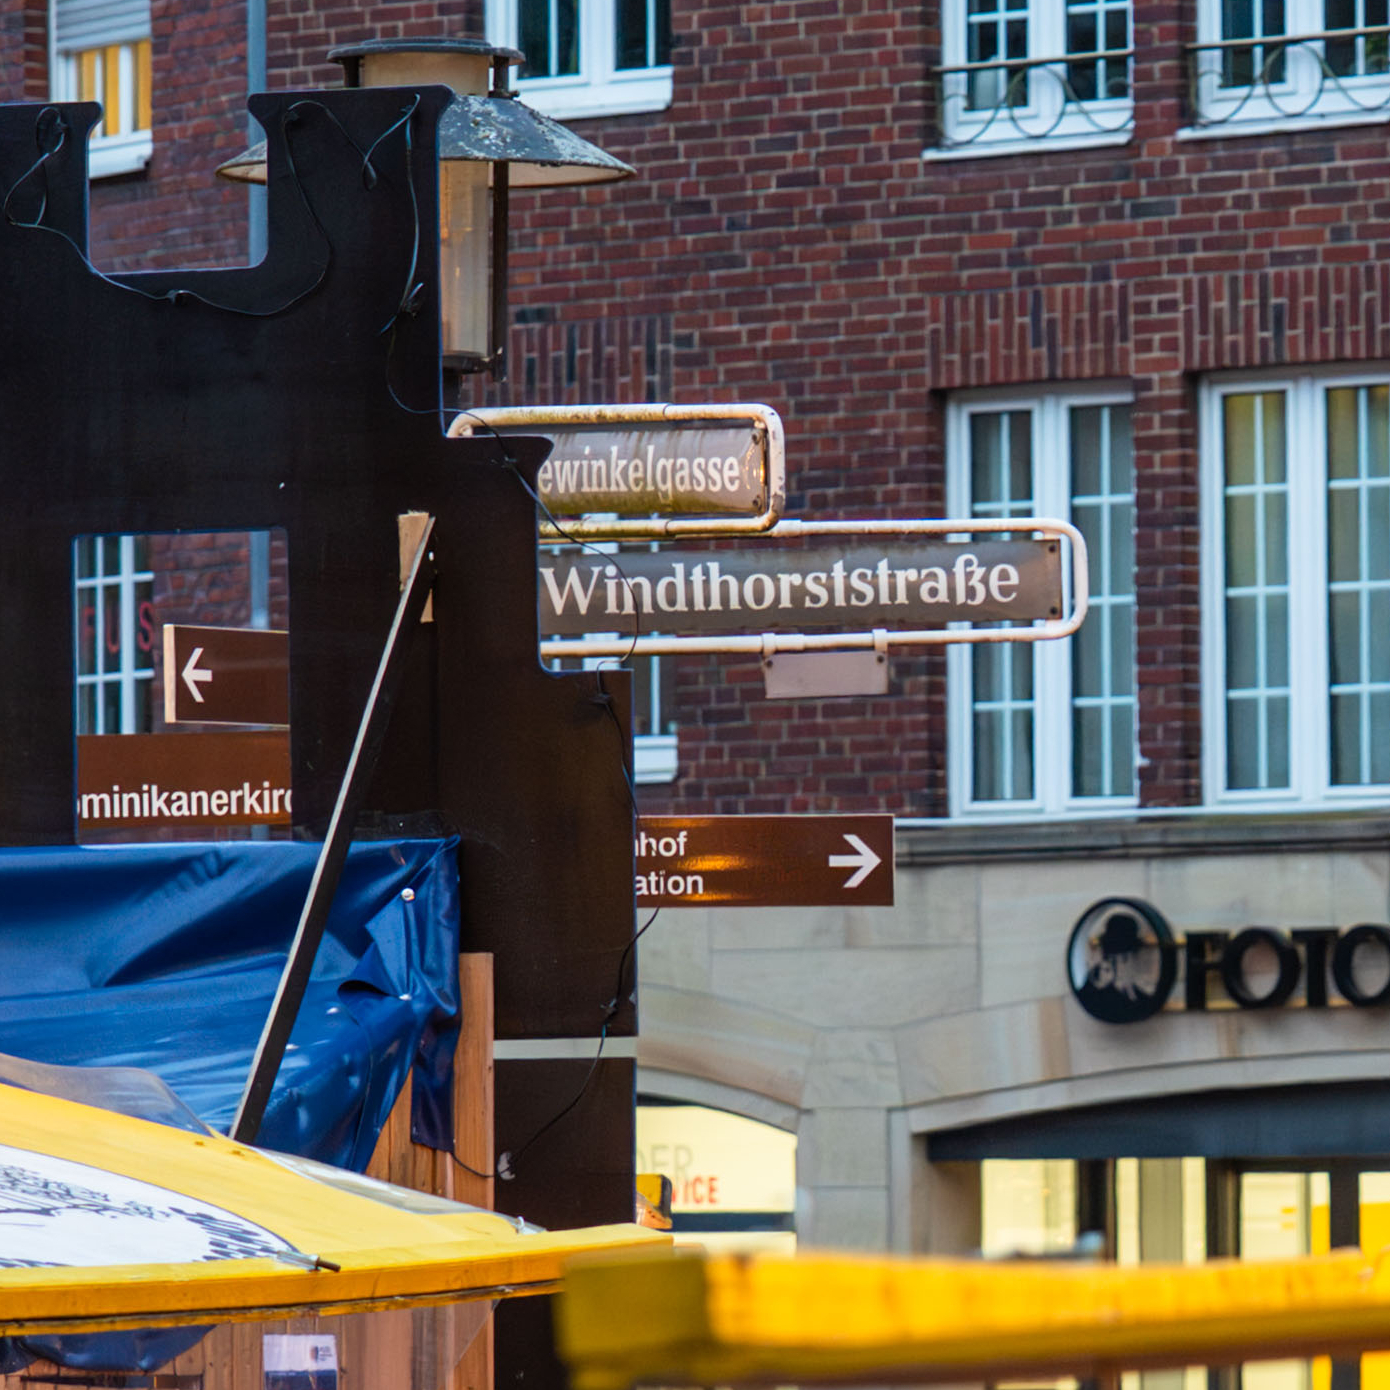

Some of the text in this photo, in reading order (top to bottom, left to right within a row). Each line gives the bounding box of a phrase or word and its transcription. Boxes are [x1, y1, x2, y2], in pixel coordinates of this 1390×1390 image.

[539, 554, 1020, 616] Windhorststraße
[76, 781, 292, 818] minikanerkir
[635, 831, 687, 857] hof
